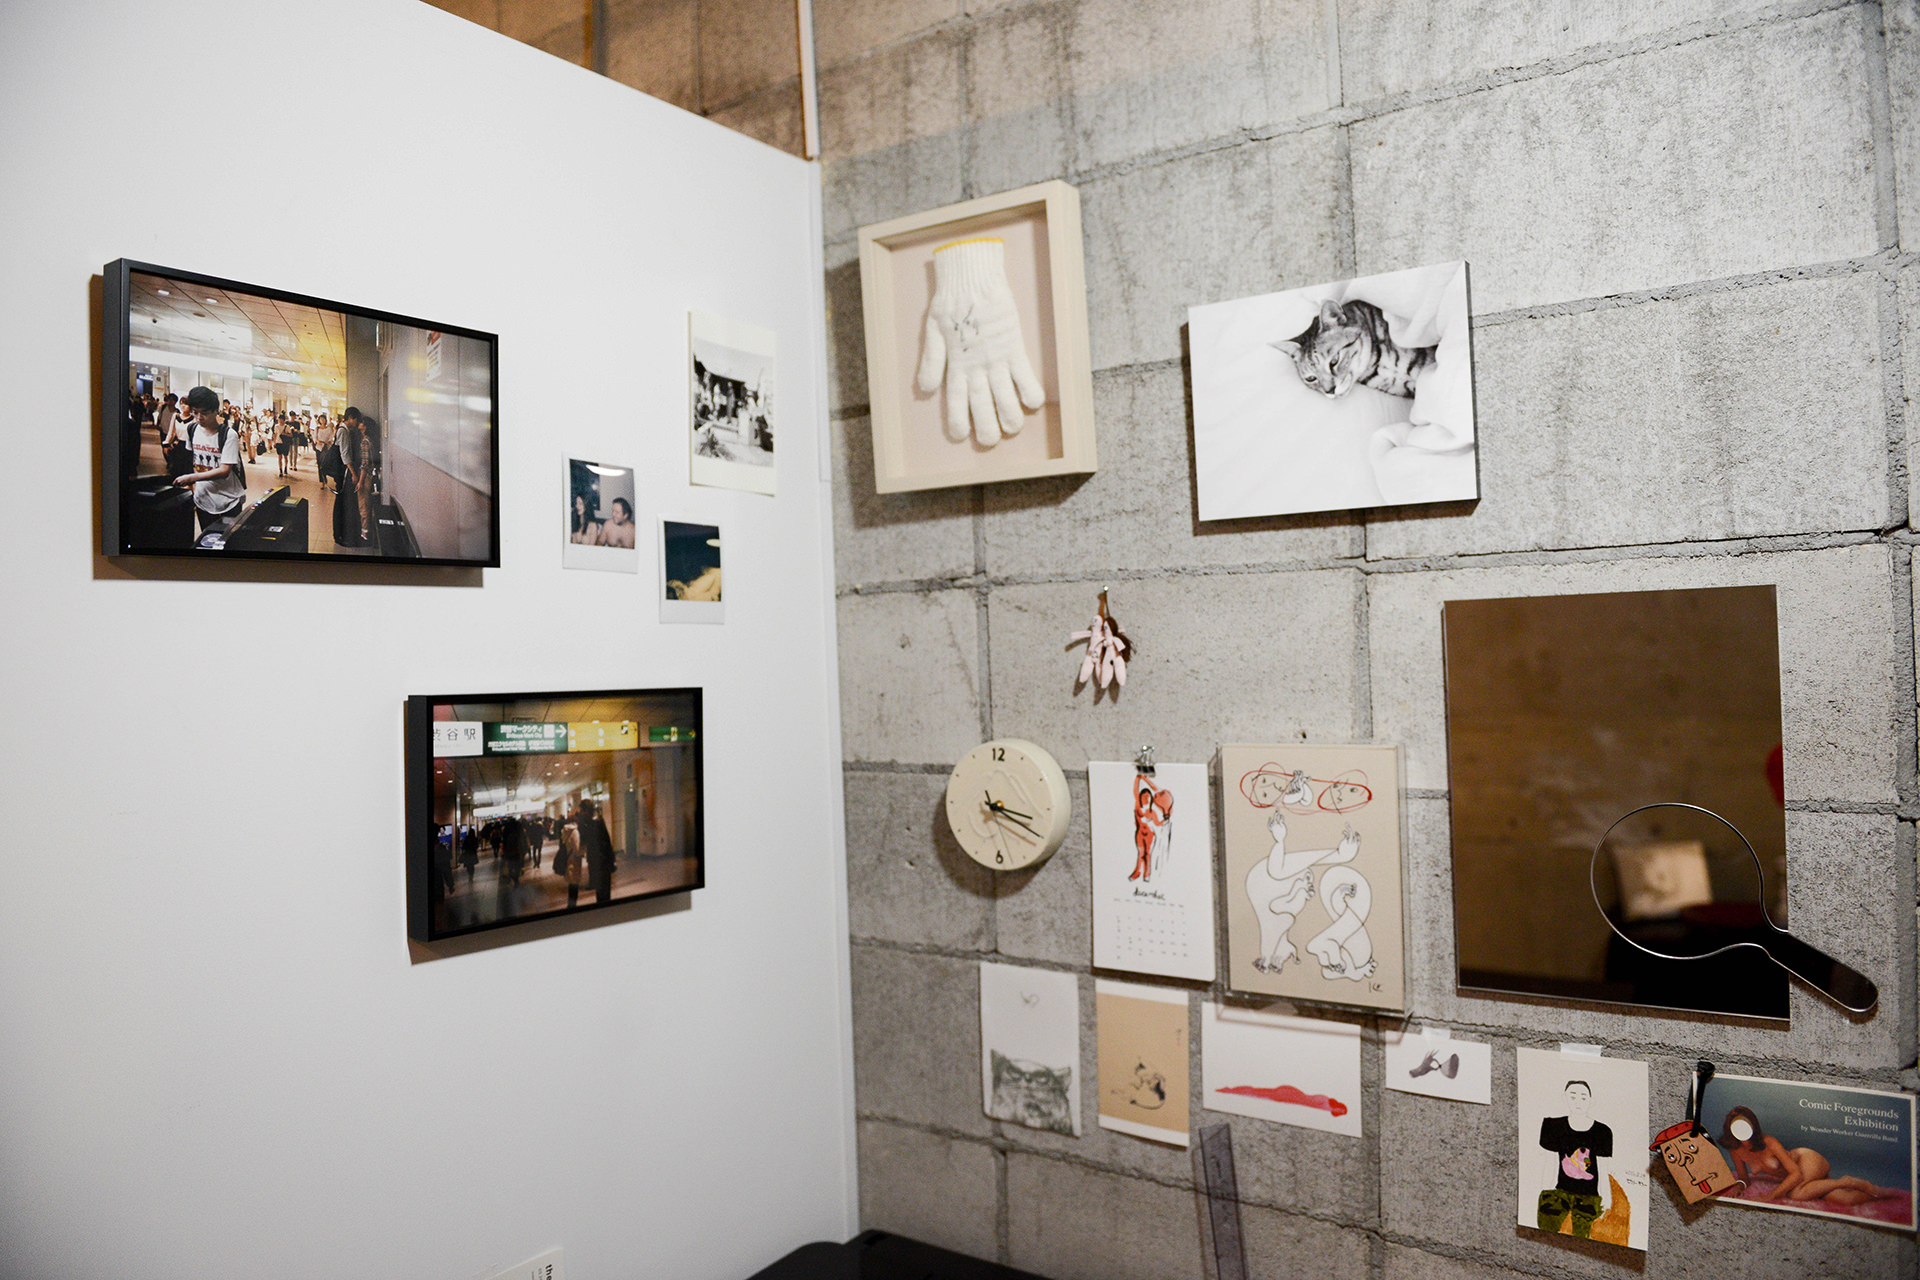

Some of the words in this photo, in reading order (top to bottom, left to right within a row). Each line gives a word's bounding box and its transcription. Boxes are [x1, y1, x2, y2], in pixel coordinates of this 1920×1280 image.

[992, 748, 1005, 761] 12
[996, 850, 1004, 864] 6
[1799, 1098, 1833, 1111] Comic
[1833, 1102, 1899, 1119] Foregrounds
[1800, 1124, 1808, 1132] by
[1809, 1125, 1832, 1134] Wonder
[1832, 1128, 1854, 1137] Worker
[1844, 1115, 1899, 1132] Exhibition
